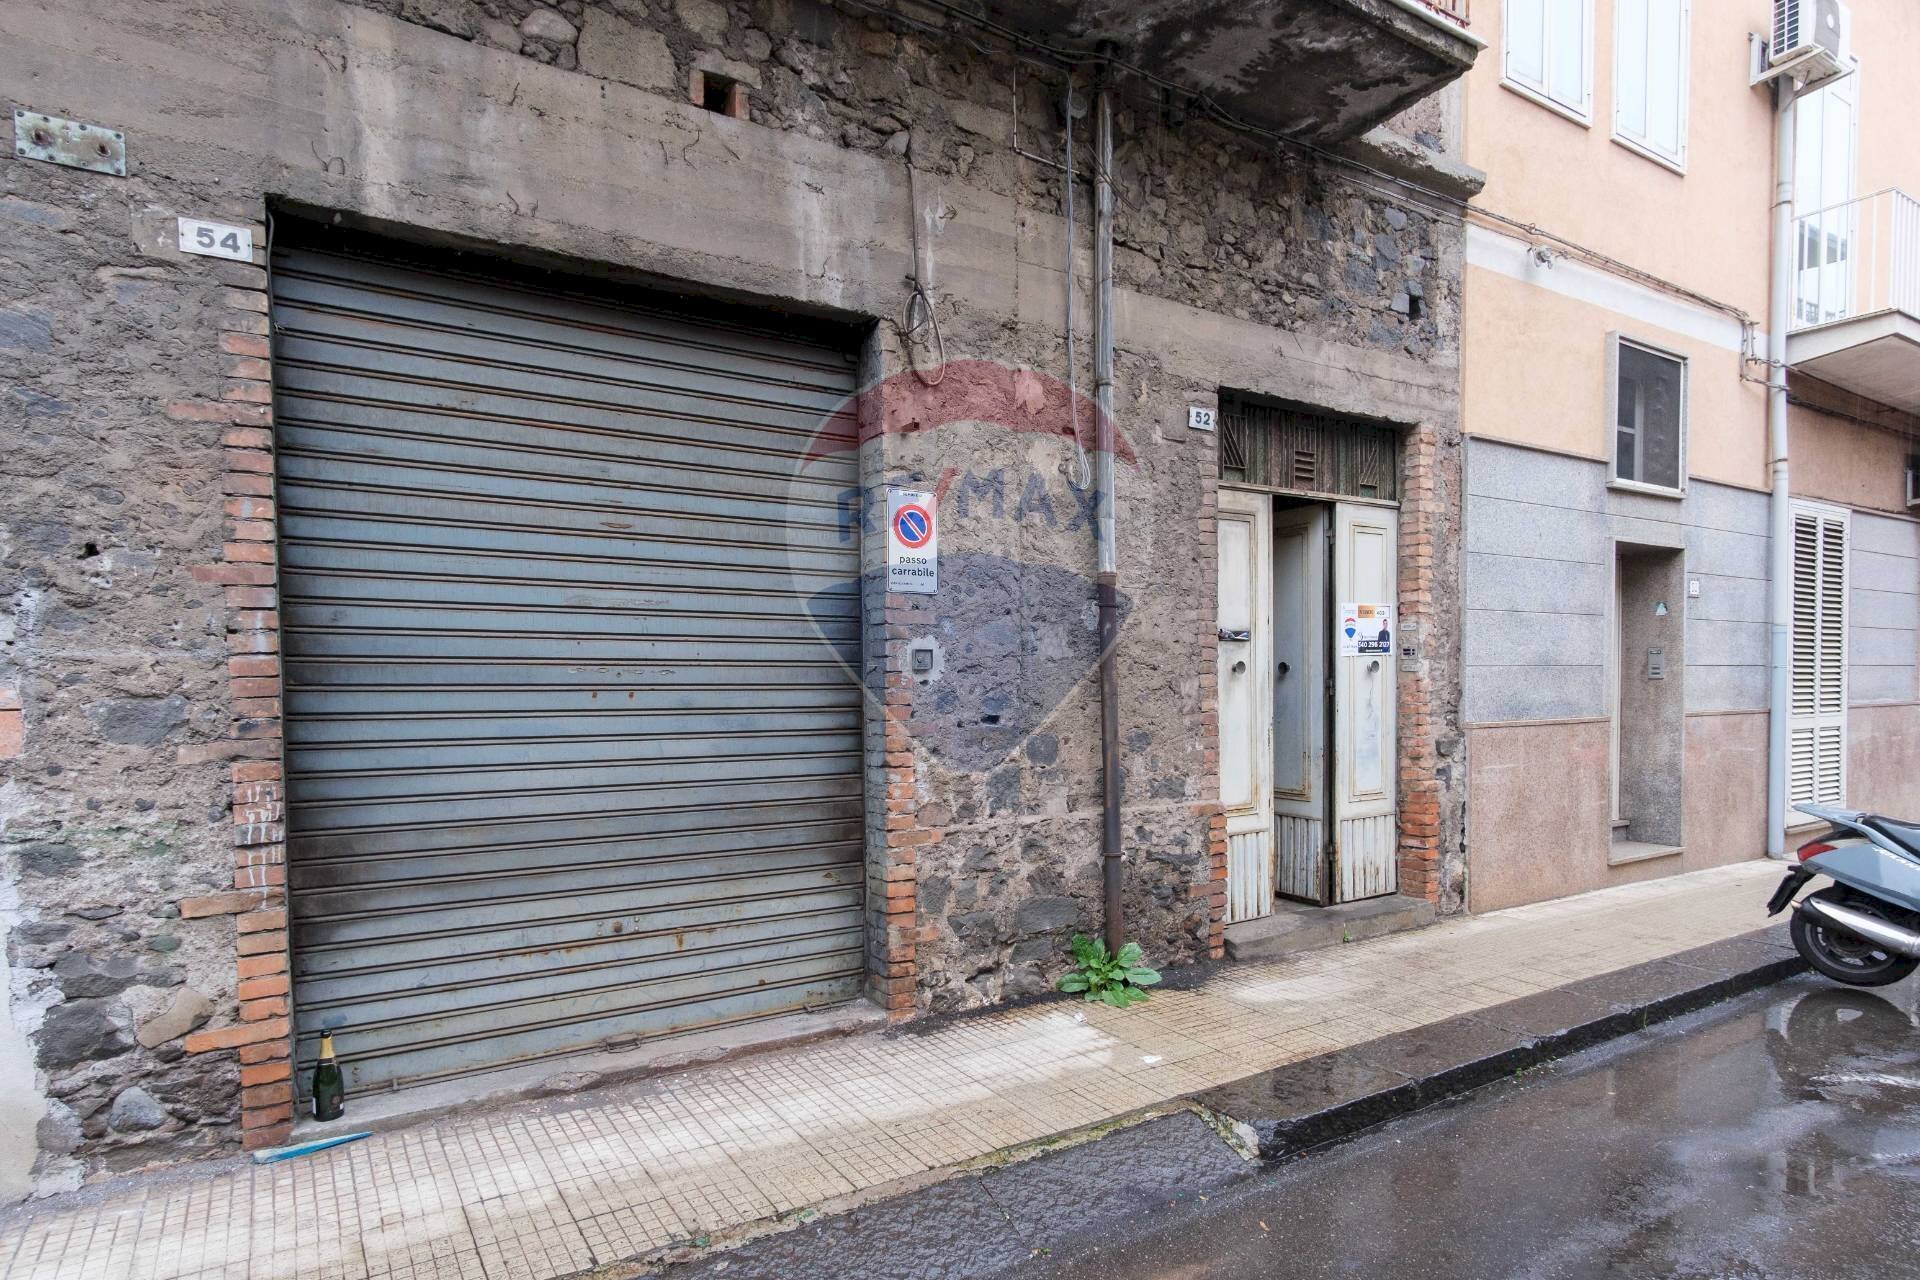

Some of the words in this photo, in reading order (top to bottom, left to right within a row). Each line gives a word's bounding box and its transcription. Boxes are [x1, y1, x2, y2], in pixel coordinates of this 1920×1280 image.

[196, 226, 241, 253] 54
[1195, 411, 1211, 426] 52
[899, 556, 928, 565] passo
[891, 567, 935, 577] carrabile
